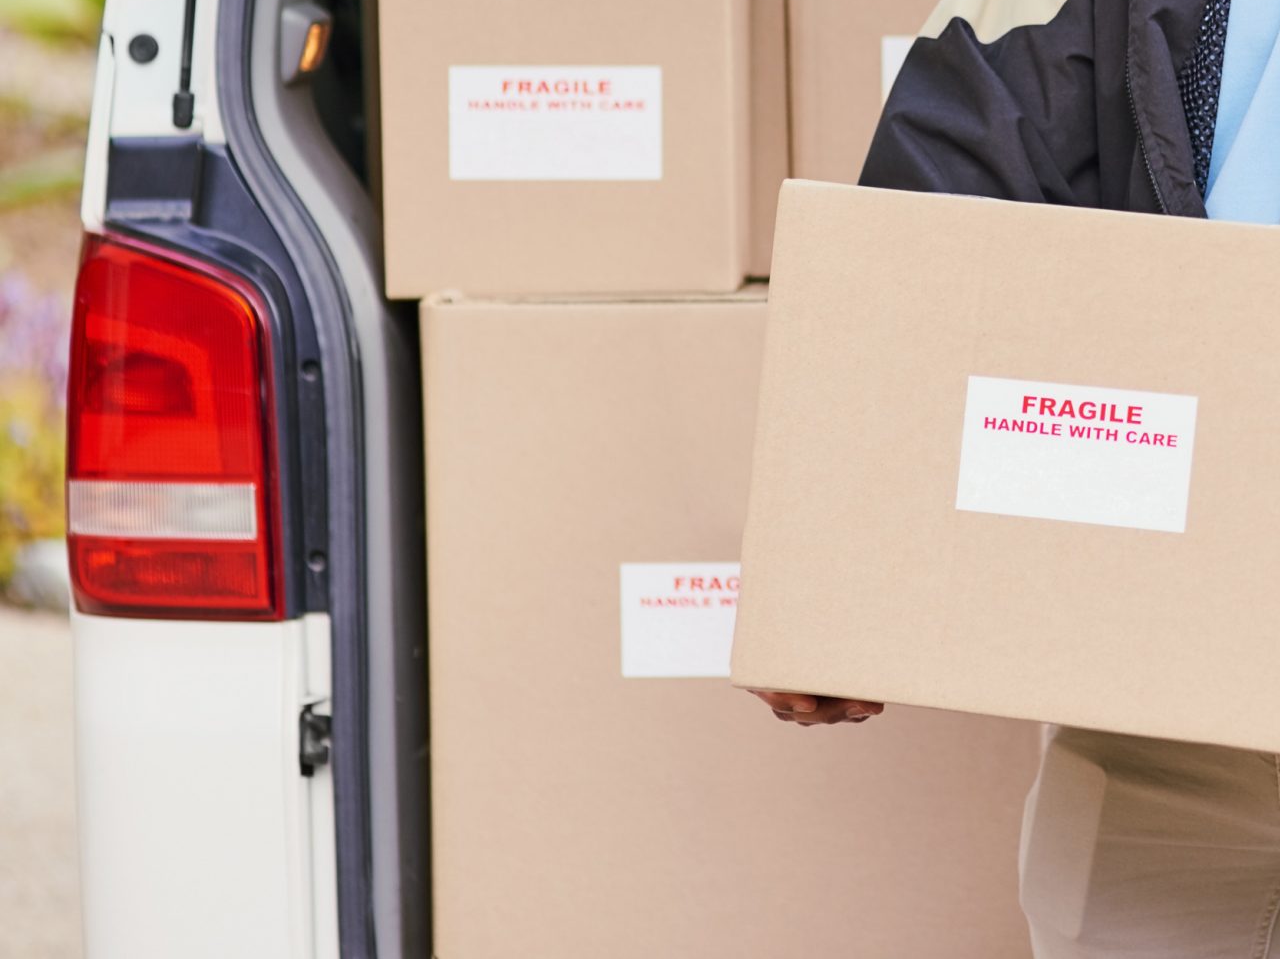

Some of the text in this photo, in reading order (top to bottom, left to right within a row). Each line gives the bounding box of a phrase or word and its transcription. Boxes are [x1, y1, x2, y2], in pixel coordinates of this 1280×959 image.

[501, 80, 611, 96] FRAGILE
[468, 100, 539, 110] HANDLE
[547, 100, 592, 110] WITH
[1021, 395, 1143, 425] FRAGILE
[983, 416, 1178, 448] HANDLE WITH CARE
[673, 576, 740, 592] FRAG
[640, 597, 712, 608] HANDLE
